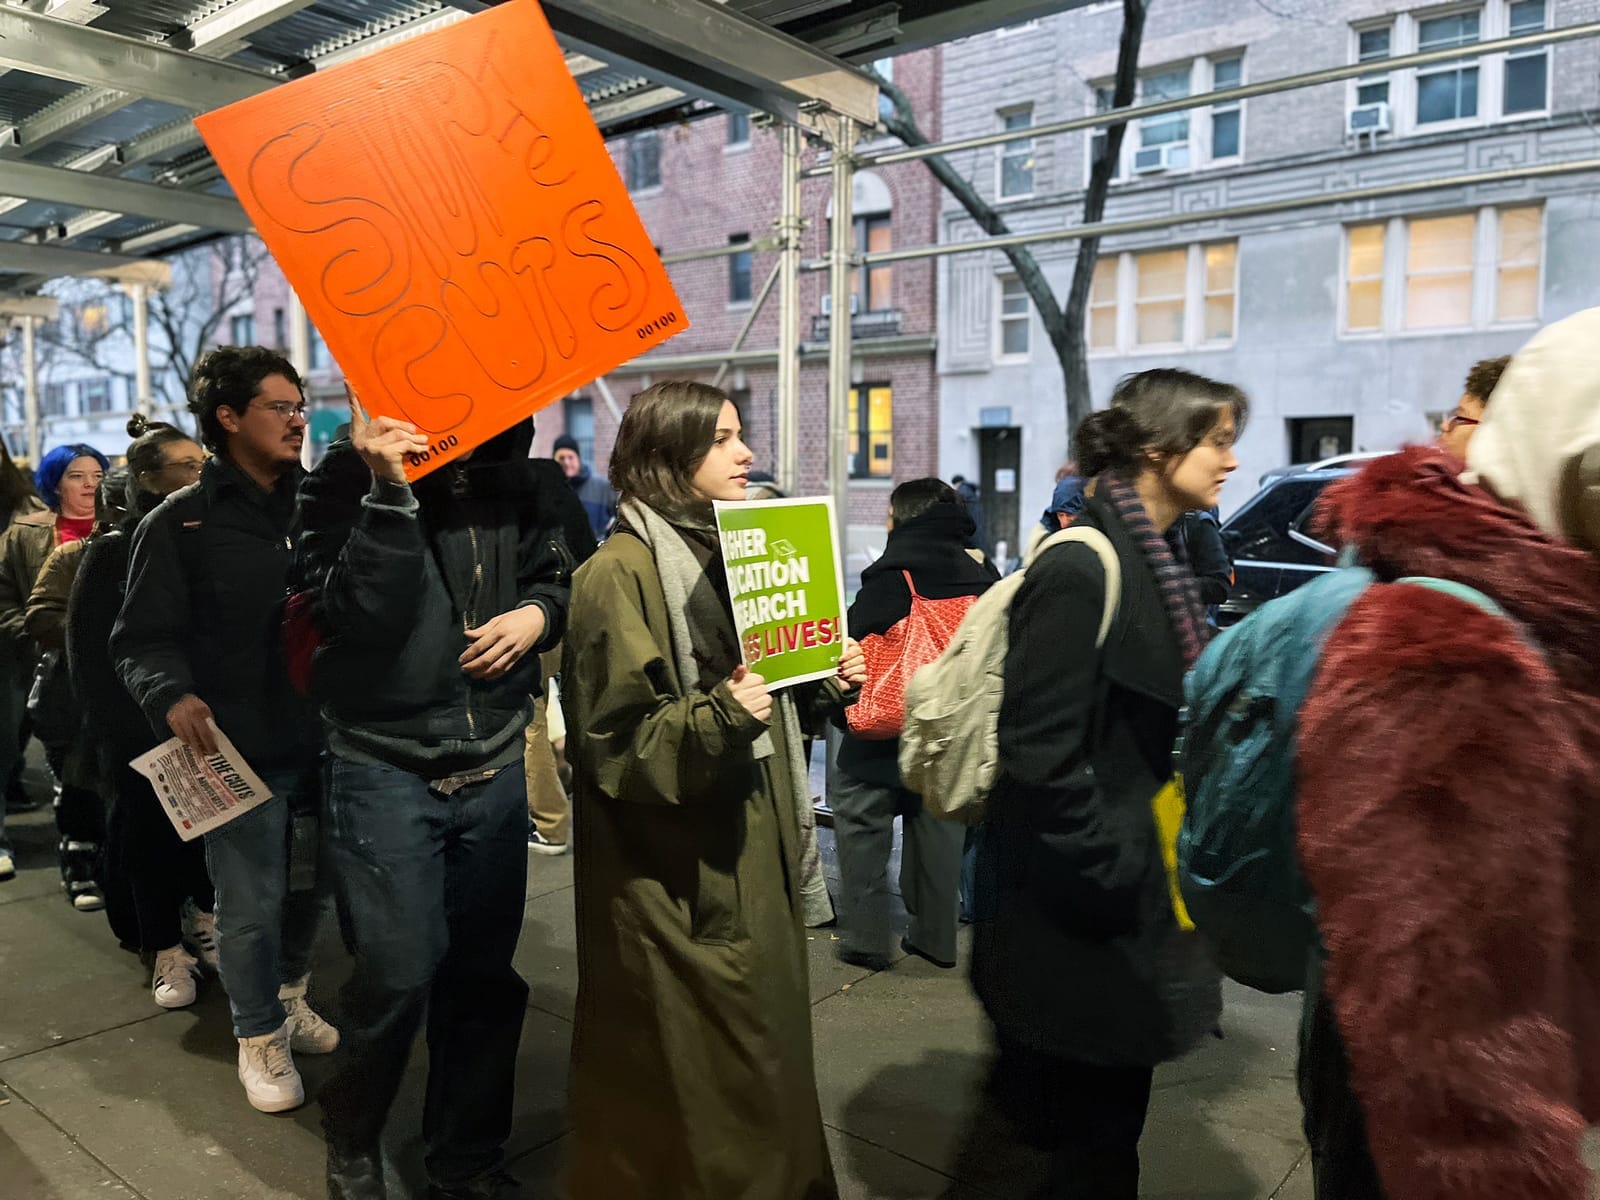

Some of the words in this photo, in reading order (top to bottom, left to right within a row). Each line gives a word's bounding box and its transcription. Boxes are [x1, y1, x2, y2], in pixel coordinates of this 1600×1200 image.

[372, 199, 650, 434] CUTS
[636, 311, 677, 339] 00100
[727, 556, 810, 597] CATION
[734, 589, 808, 631] EARCH
[765, 616, 841, 657] LIVES!
[208, 754, 233, 777] THE
[224, 773, 256, 800] CUTS
